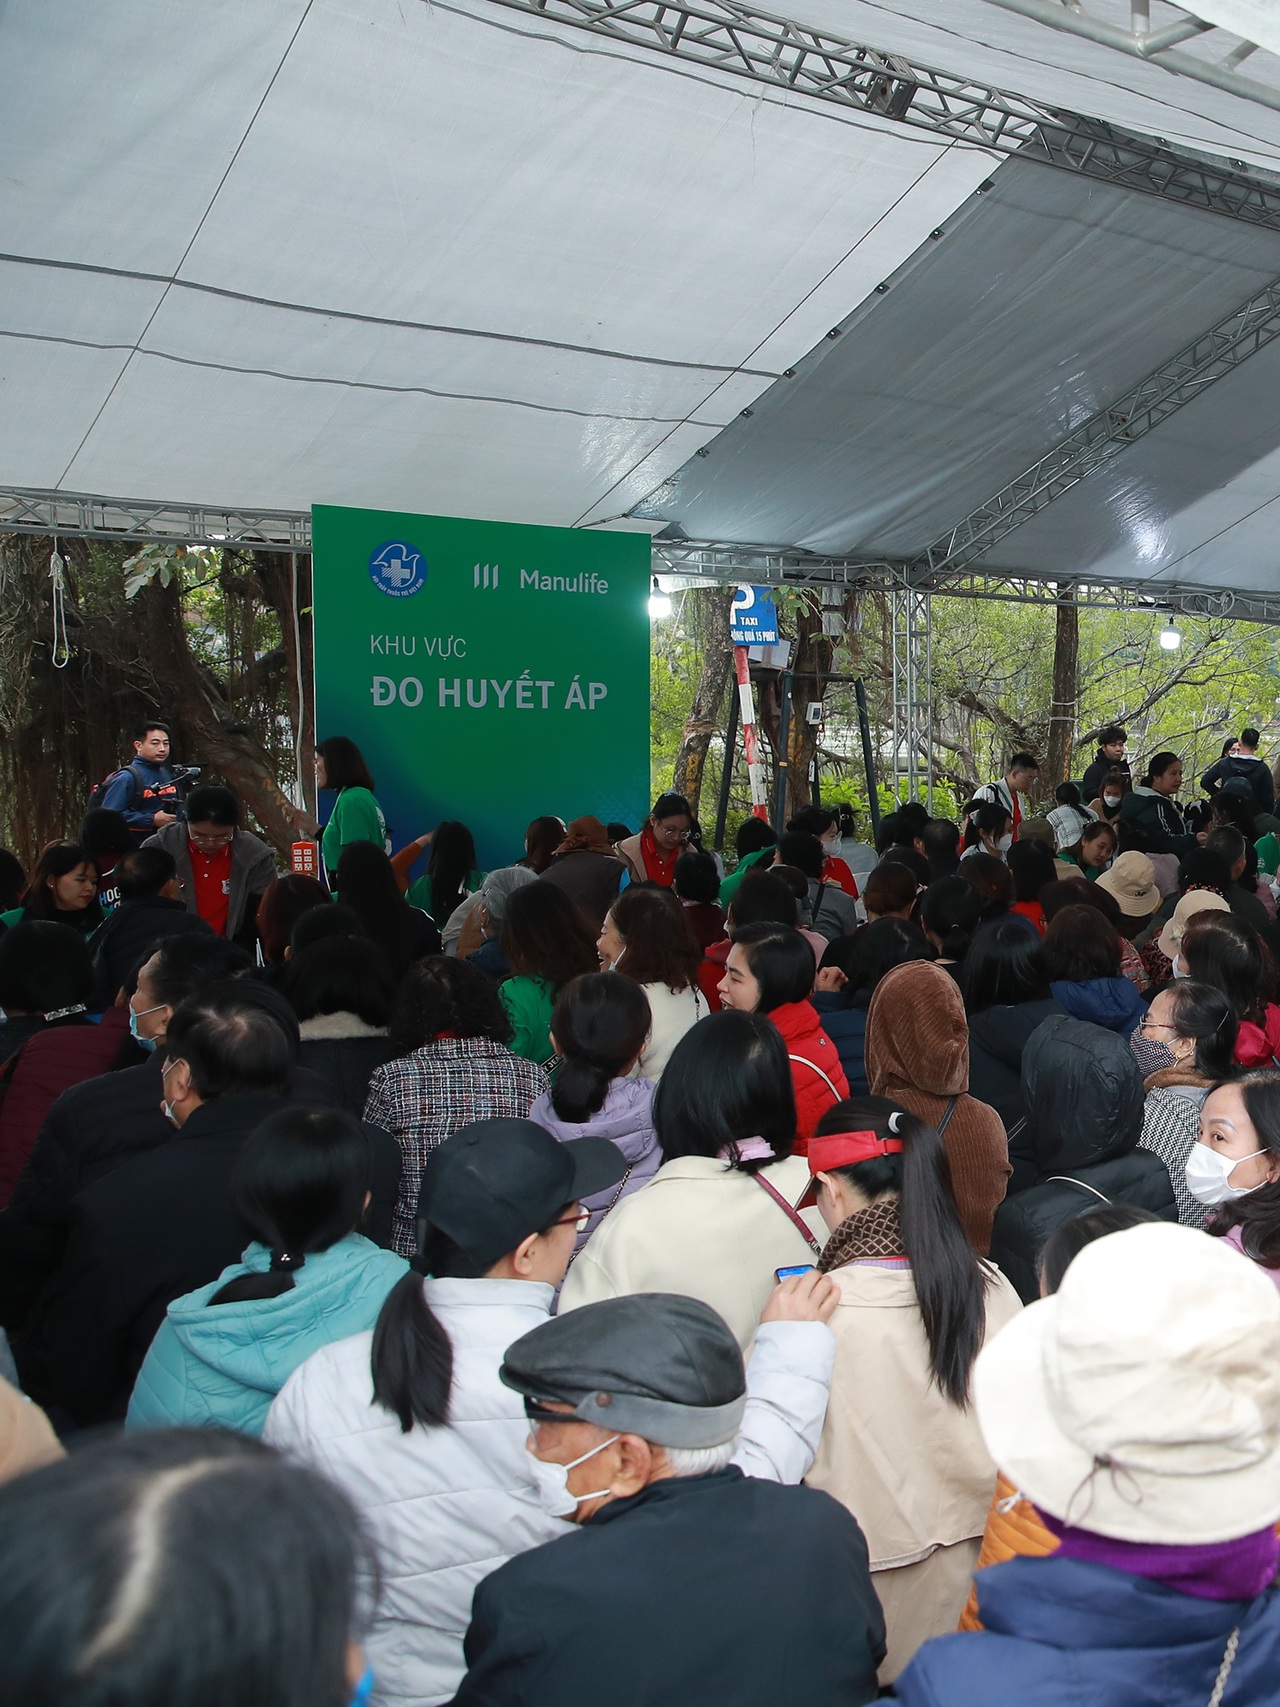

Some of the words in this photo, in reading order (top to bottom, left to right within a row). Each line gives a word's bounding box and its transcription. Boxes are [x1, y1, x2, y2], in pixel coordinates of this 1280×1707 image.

[520, 568, 609, 595] Manulife
[740, 617, 758, 626] TAXI
[370, 634, 416, 656] KHU
[423, 634, 467, 661] VỰC
[755, 630, 763, 642] 15
[370, 675, 424, 707] ĐO
[438, 669, 555, 709] HUYẾT
[564, 674, 608, 710] ÁP
